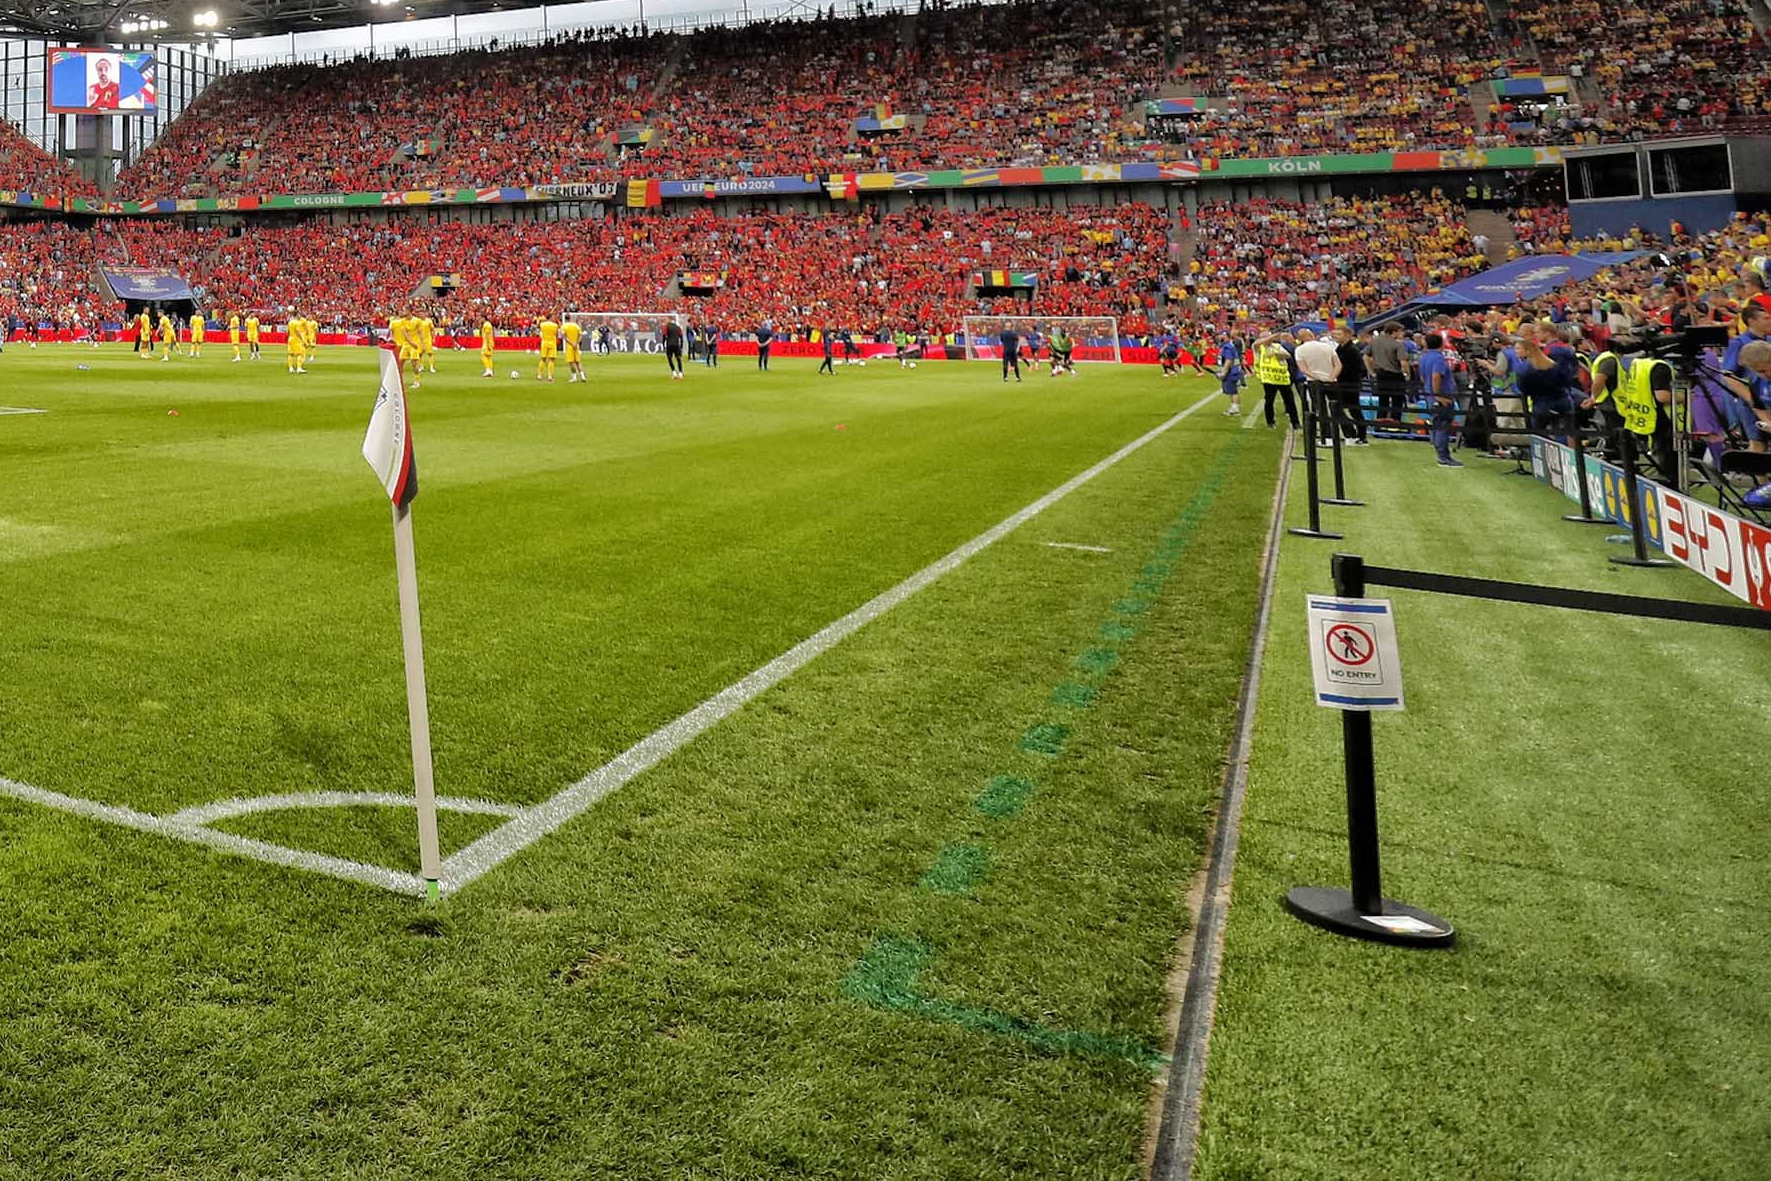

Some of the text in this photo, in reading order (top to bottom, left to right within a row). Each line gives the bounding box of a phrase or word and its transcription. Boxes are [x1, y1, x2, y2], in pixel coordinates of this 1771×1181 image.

[1268, 159, 1321, 172] KÖLN
[293, 196, 345, 205] COLOGNE
[1664, 493, 1733, 587] BYD
[1331, 668, 1378, 679] NO ENTRY
